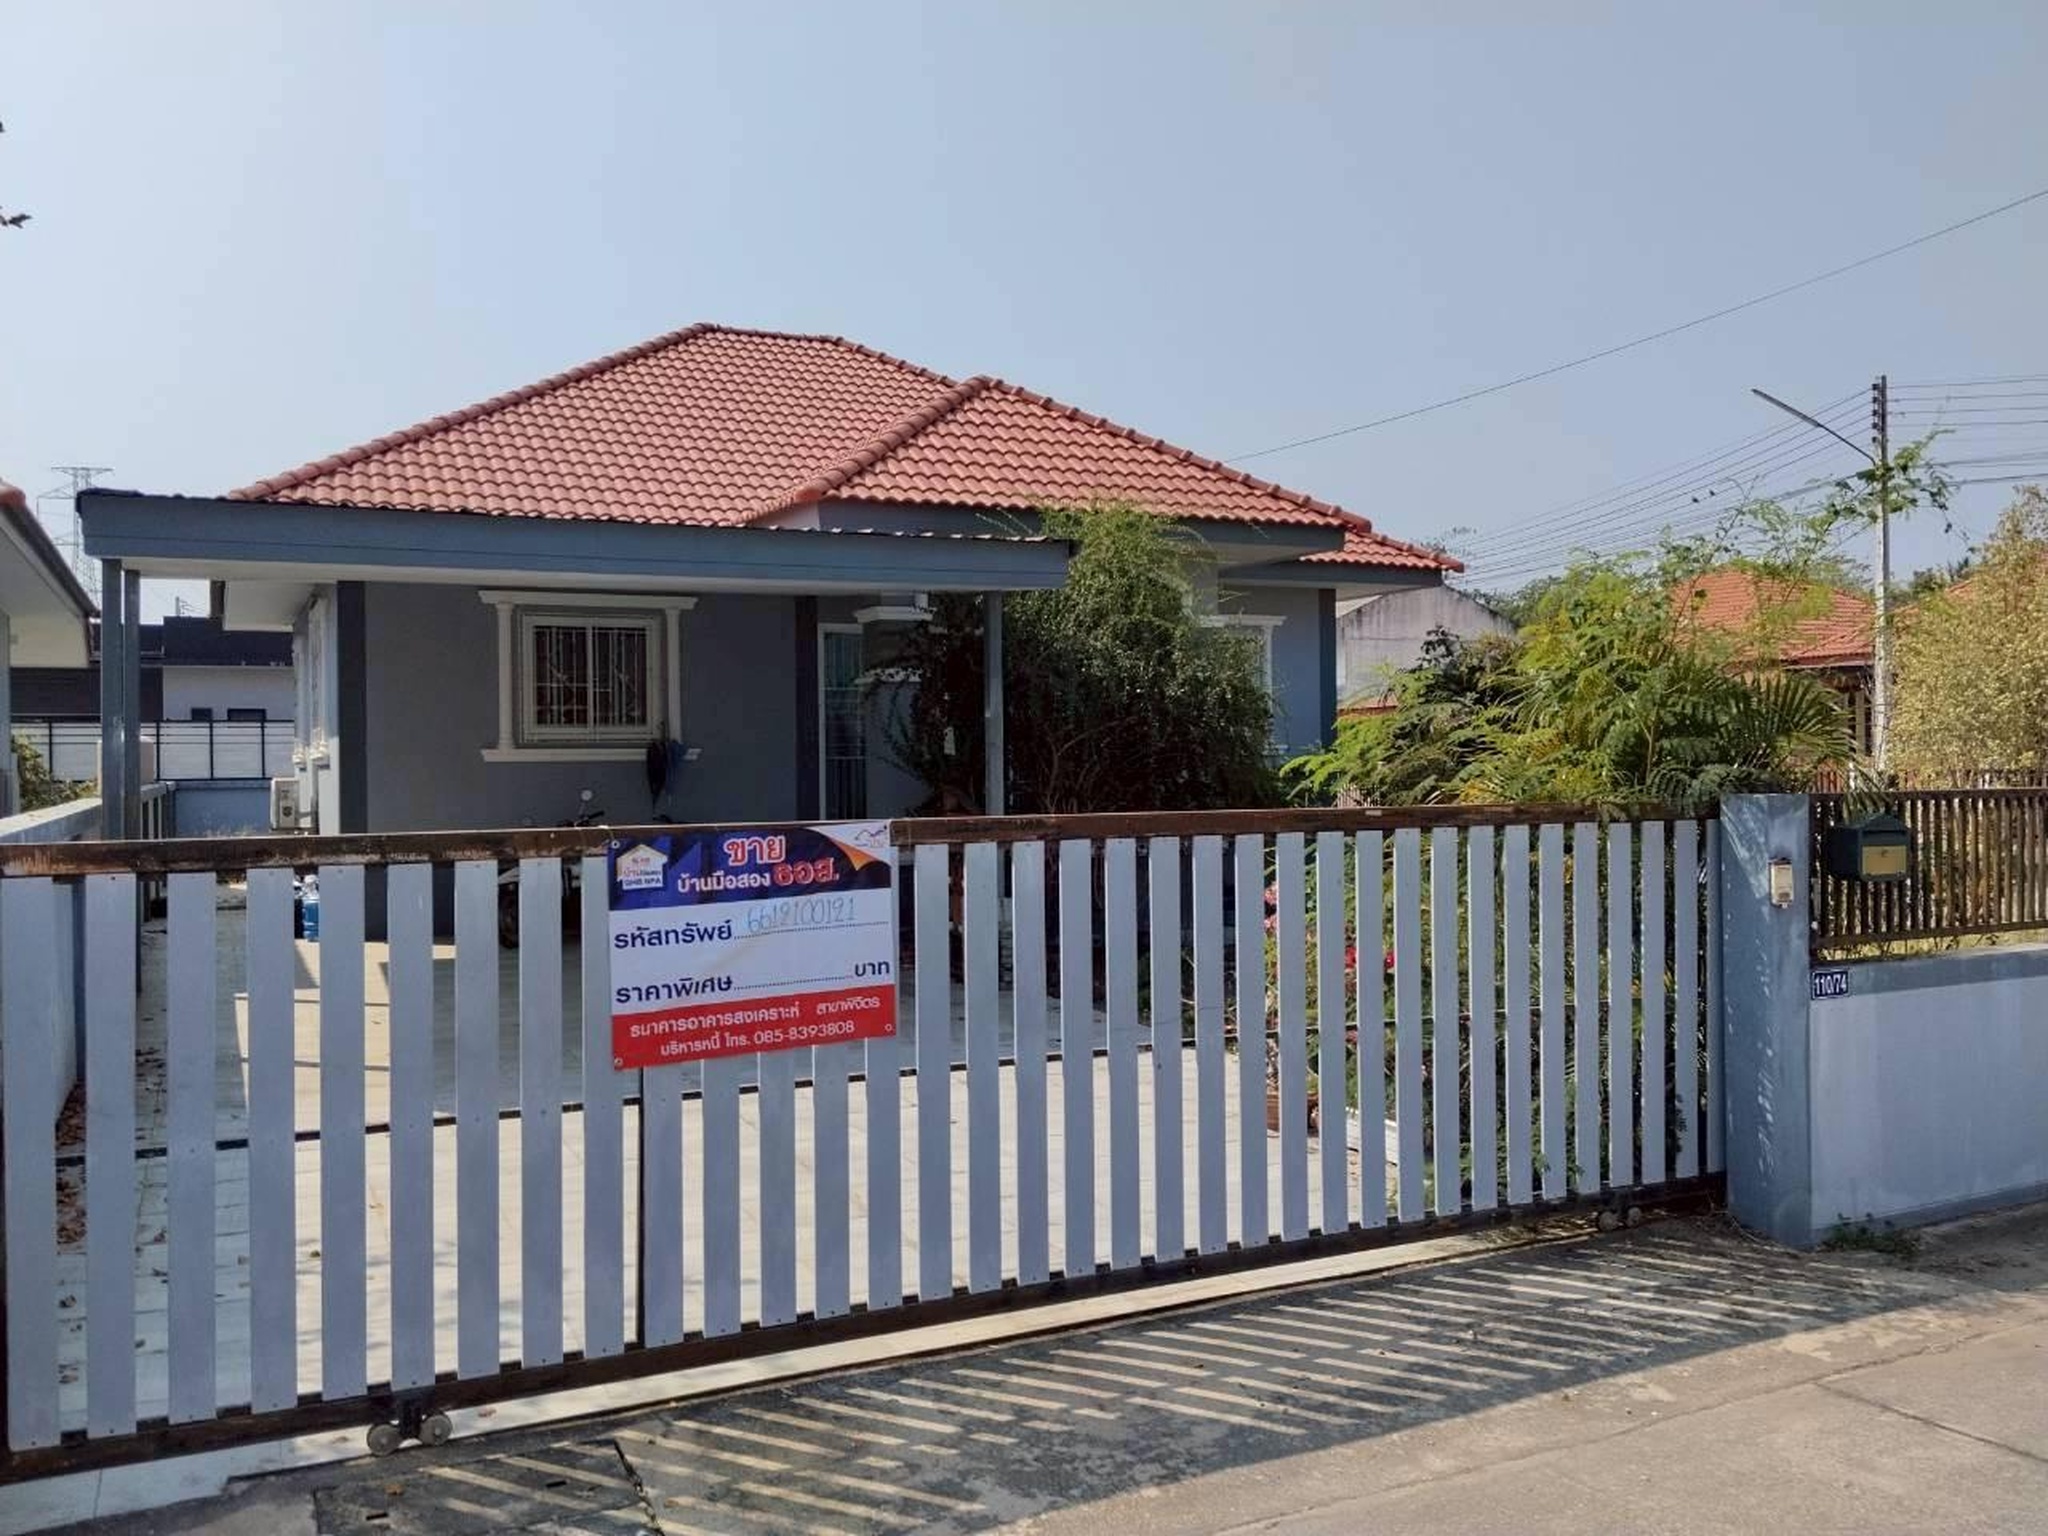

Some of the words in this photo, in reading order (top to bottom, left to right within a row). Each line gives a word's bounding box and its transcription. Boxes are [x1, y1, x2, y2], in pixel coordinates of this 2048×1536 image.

[724, 835, 786, 866] ขาย
[678, 870, 771, 893] บ้านมือสอง
[614, 919, 733, 949] รหัสทรัพย์
[855, 960, 890, 977] บาท
[616, 976, 733, 1003] ราคาพิเศษ
[630, 1001, 801, 1038] ธนาคารอาคารสงเคราะห์
[660, 1031, 720, 1056] บริหารหนี้
[725, 1031, 751, 1047] โทร.
[754, 1020, 855, 1044] 085-8393808
